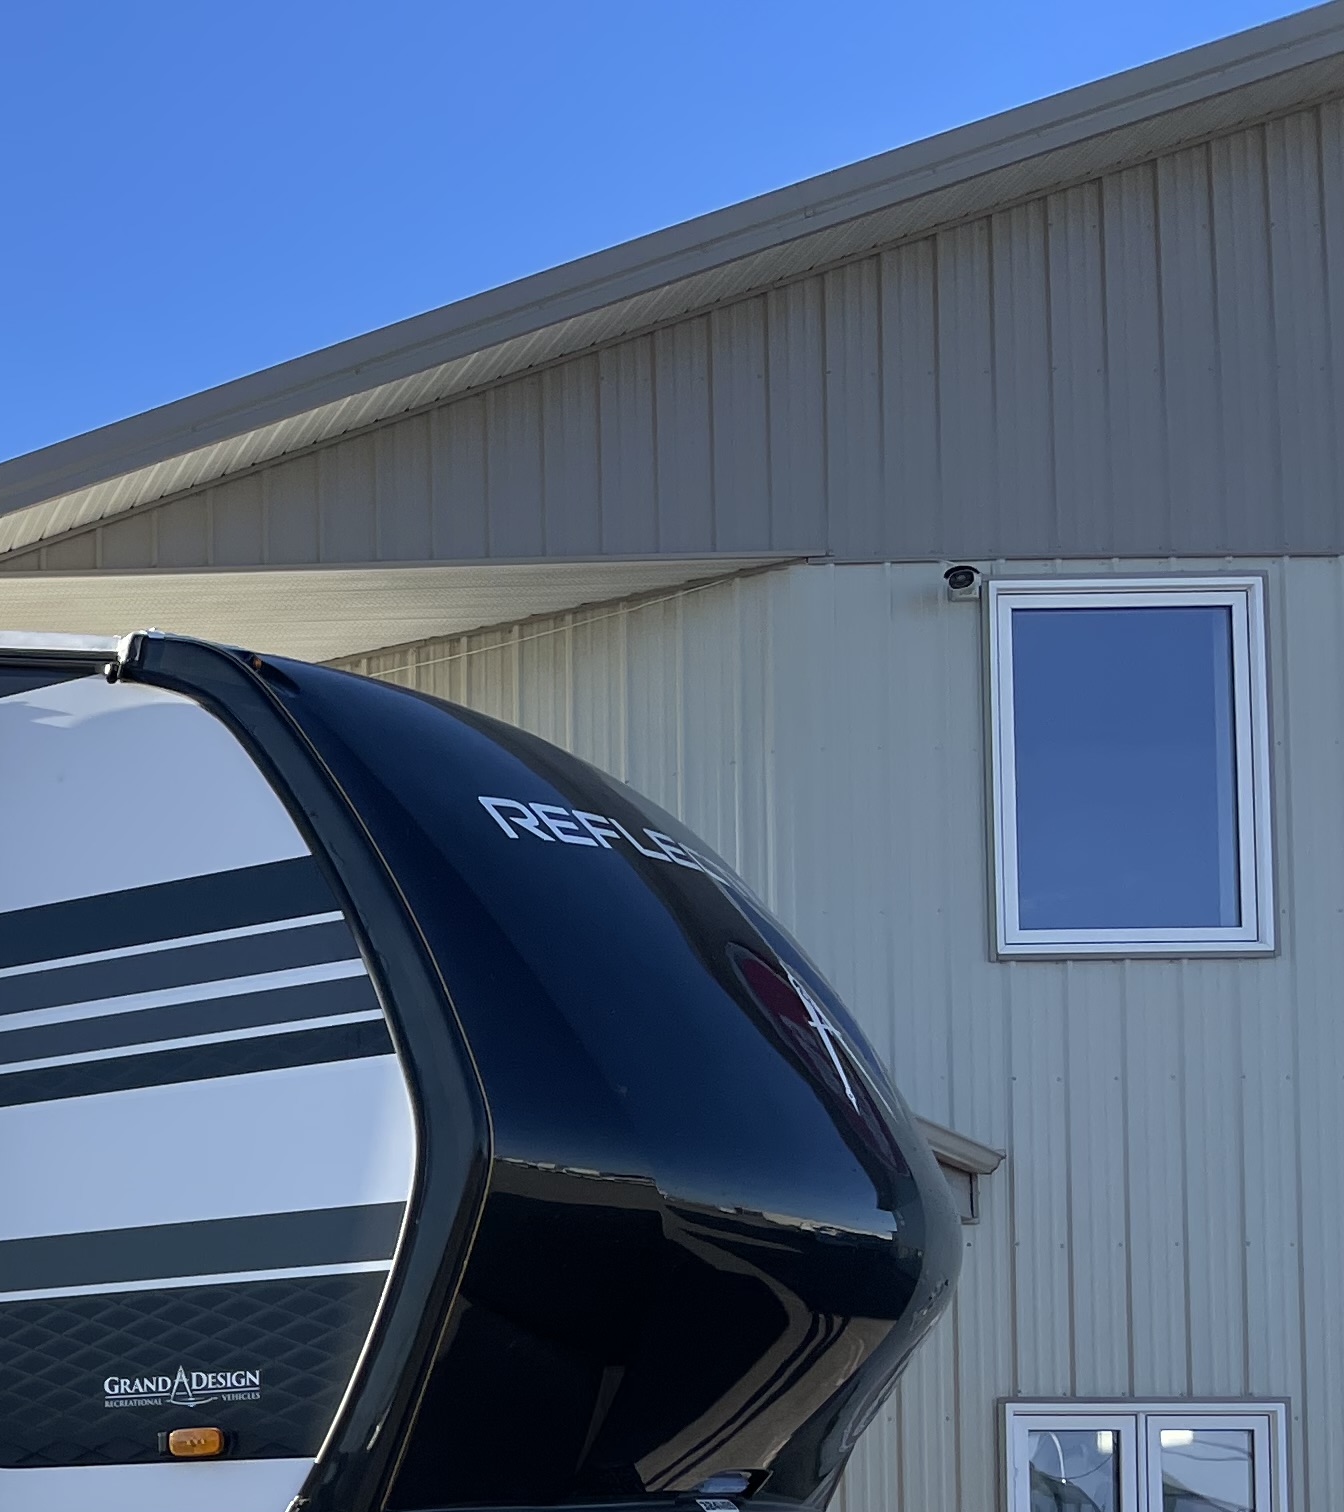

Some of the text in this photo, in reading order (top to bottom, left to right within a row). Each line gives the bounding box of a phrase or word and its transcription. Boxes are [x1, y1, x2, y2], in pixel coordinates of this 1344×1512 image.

[103, 1370, 261, 1394] GRAND DESIGN
[104, 1392, 261, 1408] RECREATIONAL VEHICLES
